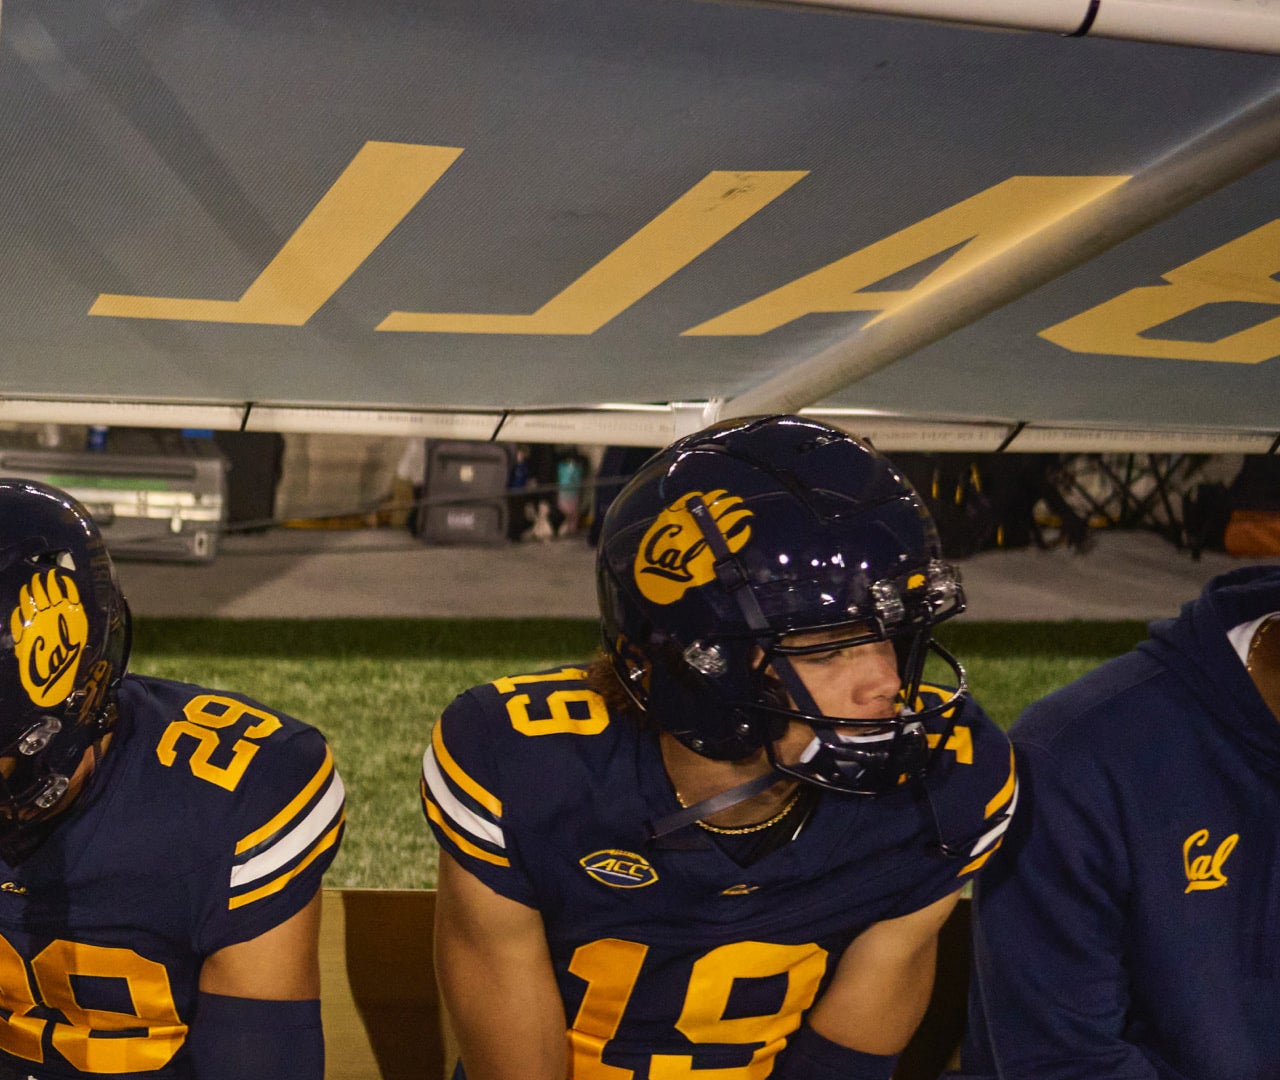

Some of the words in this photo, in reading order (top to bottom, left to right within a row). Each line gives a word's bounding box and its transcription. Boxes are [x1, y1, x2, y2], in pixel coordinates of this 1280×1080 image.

[640, 523, 708, 583] Cal
[28, 613, 82, 700] Cal
[492, 667, 611, 737] 19
[156, 694, 284, 793] 29
[1182, 828, 1240, 894] Cal
